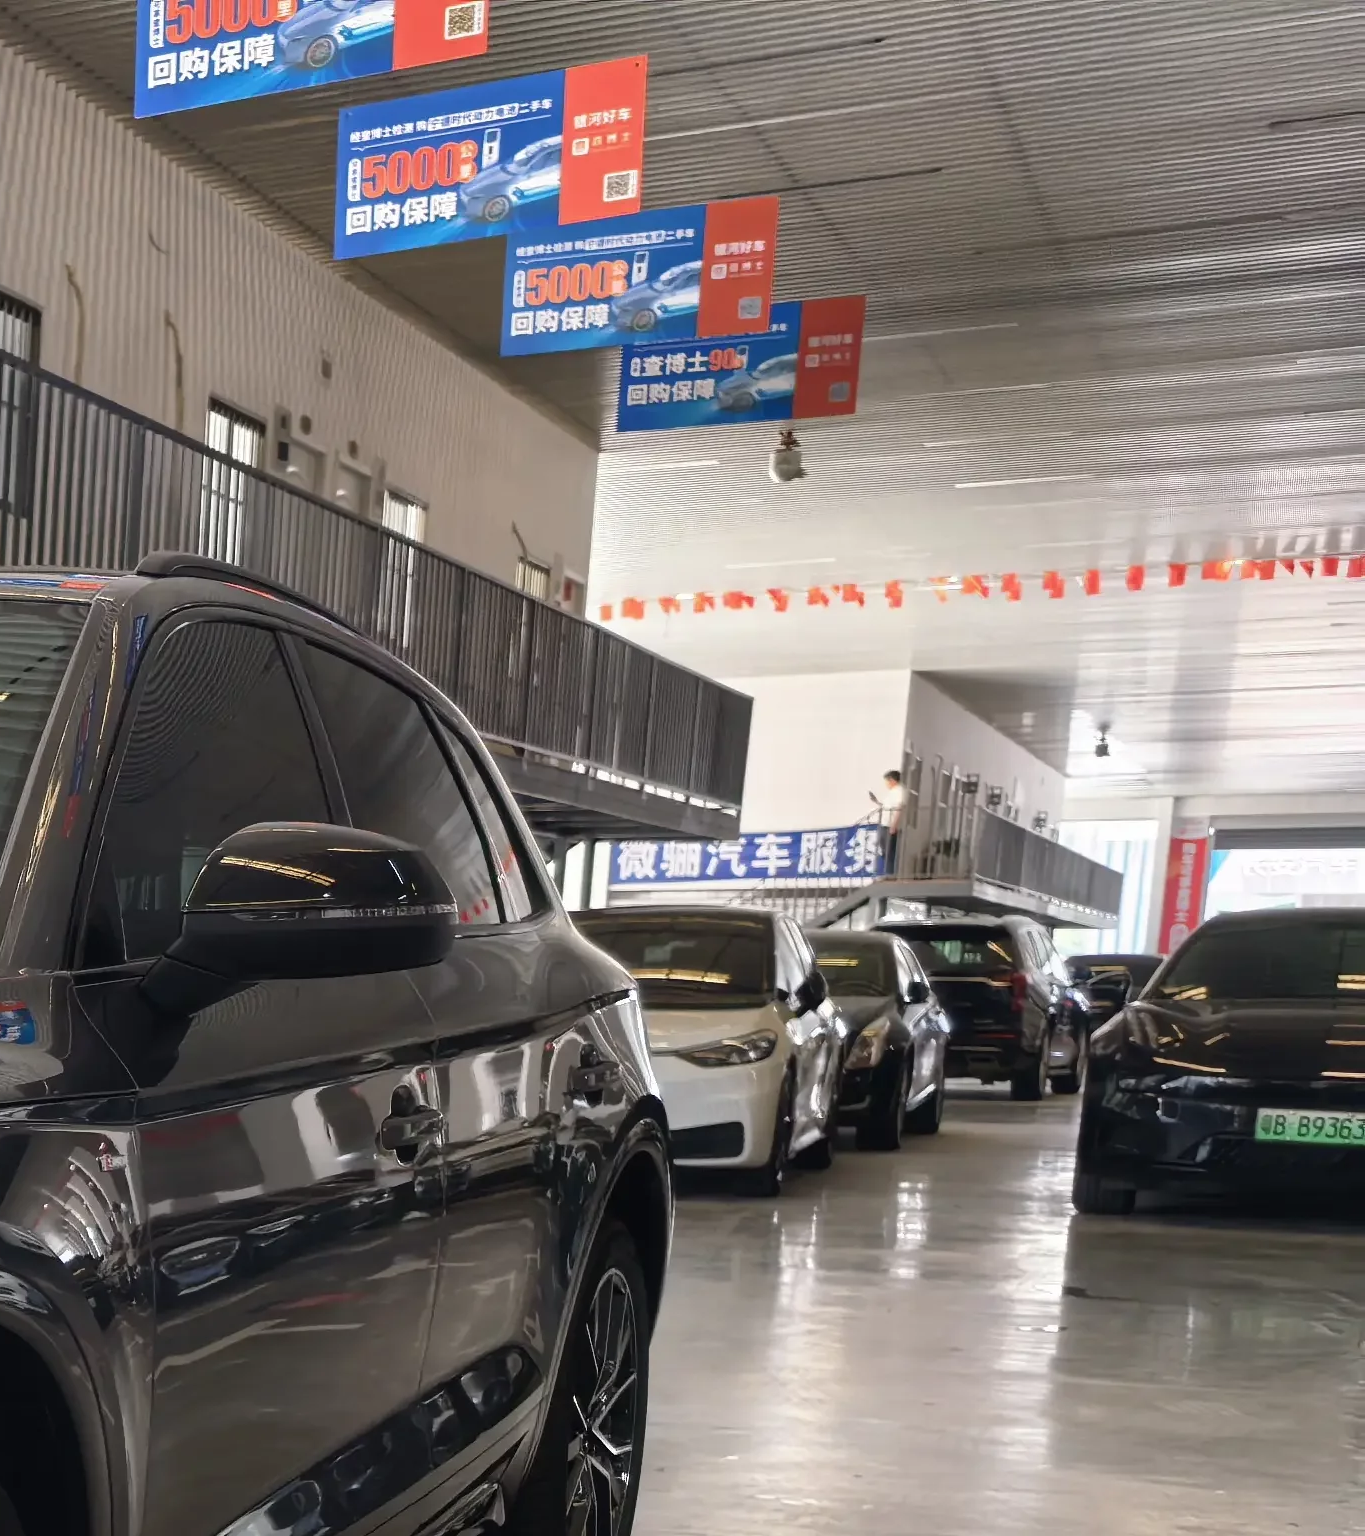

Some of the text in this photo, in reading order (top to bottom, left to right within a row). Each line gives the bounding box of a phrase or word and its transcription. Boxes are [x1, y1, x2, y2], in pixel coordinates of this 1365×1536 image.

[147, 33, 277, 89] 回购保障
[362, 142, 463, 199] 5000
[345, 191, 458, 236] 回购保障
[526, 260, 614, 306] 5000
[510, 303, 610, 337] 回购保障
[627, 378, 715, 406] 回购保障
